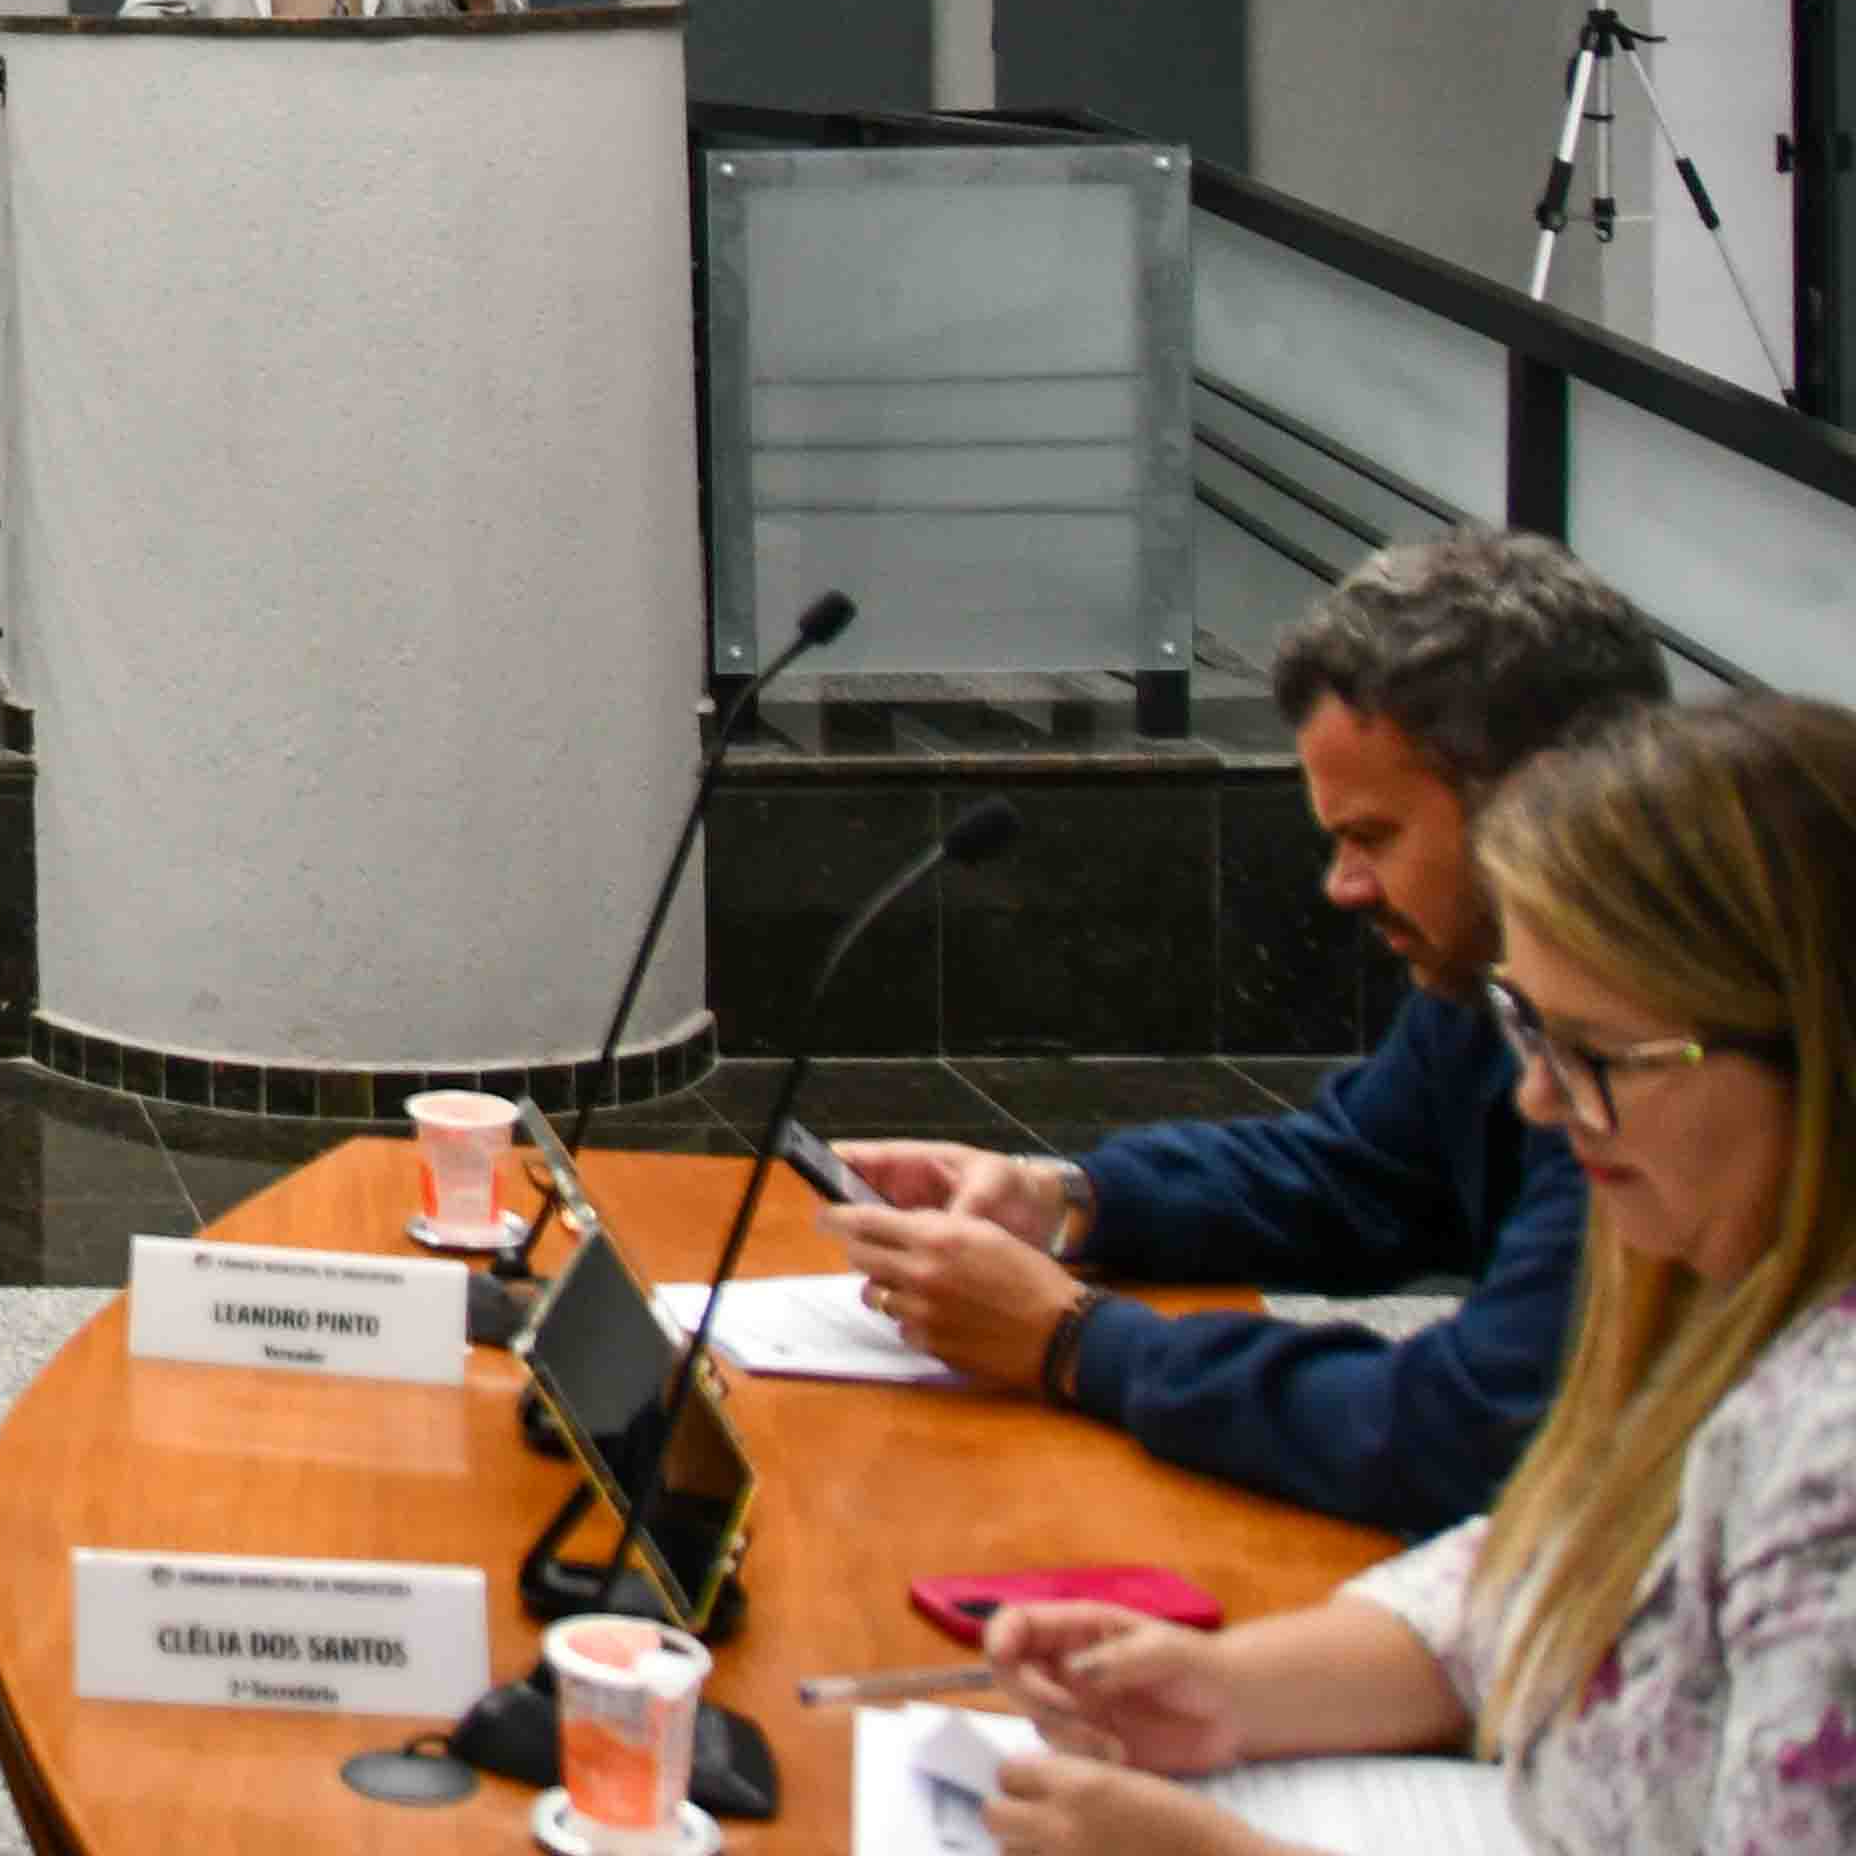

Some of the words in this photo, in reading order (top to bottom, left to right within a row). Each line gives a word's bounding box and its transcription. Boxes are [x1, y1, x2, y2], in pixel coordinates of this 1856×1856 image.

[213, 1301, 310, 1331] LEANDRO
[315, 1307, 381, 1338] PINTO
[156, 1623, 242, 1656] CLÉLIA
[248, 1631, 300, 1661] DOS
[307, 1635, 408, 1668] SANTOS
